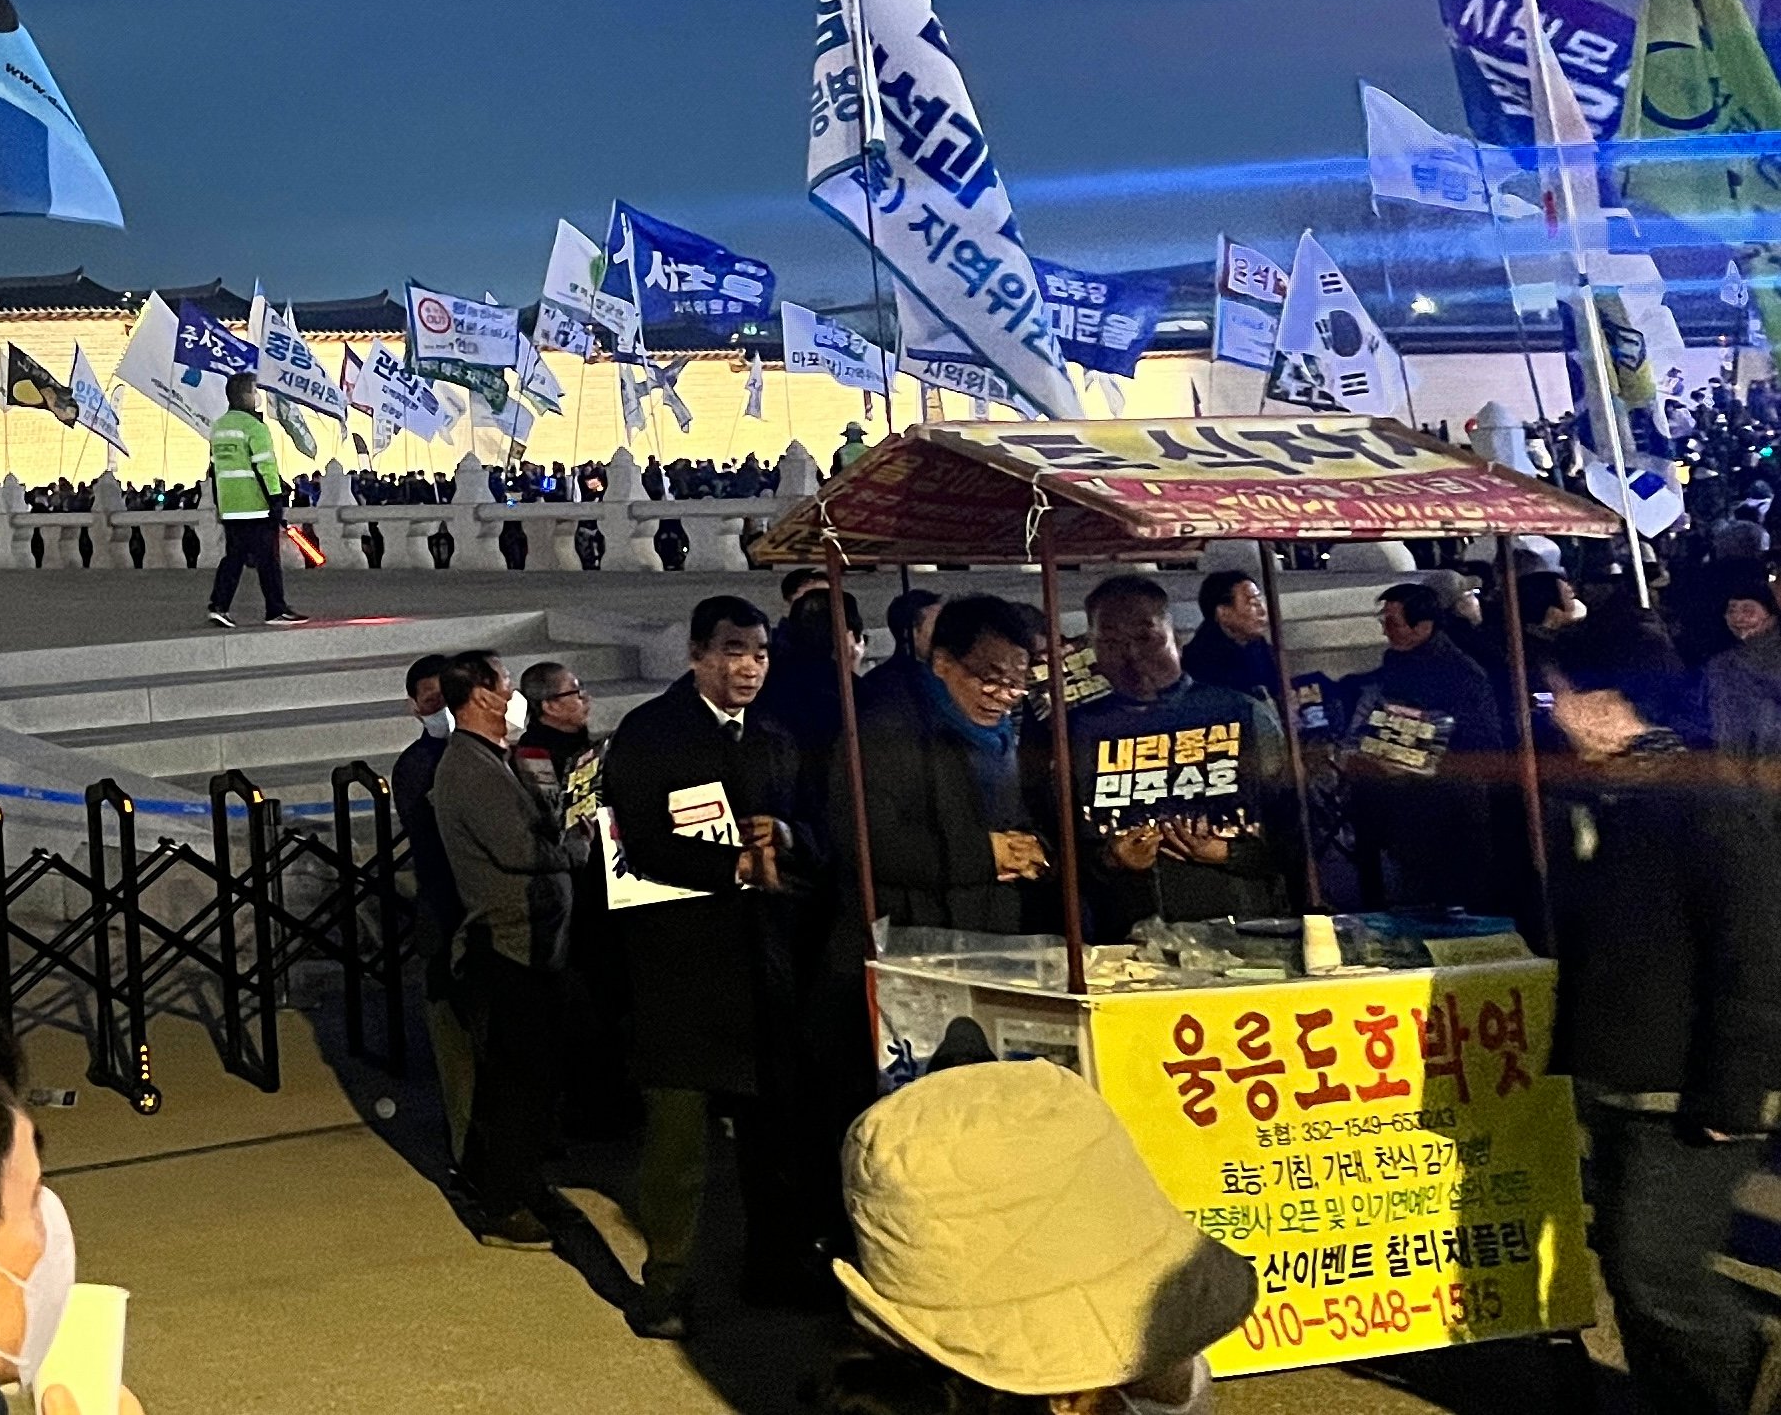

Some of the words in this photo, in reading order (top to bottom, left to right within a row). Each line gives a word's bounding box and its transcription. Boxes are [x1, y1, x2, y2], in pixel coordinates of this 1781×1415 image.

[1096, 734, 1171, 773] 내란
[1174, 722, 1240, 764] 종식
[1093, 769, 1168, 808] 민주
[1172, 758, 1239, 800] 수호
[1256, 1123, 1297, 1147] 농협:
[1221, 1161, 1267, 1195] 효능:
[1273, 1154, 1319, 1191] 기침,
[1375, 1144, 1418, 1179] 천식
[1278, 1199, 1319, 1233] 오픈
[1324, 1197, 1345, 1231] 및
[1351, 1184, 1443, 1227] 인기연예인
[1243, 1243, 1374, 1293] 산이벤트
